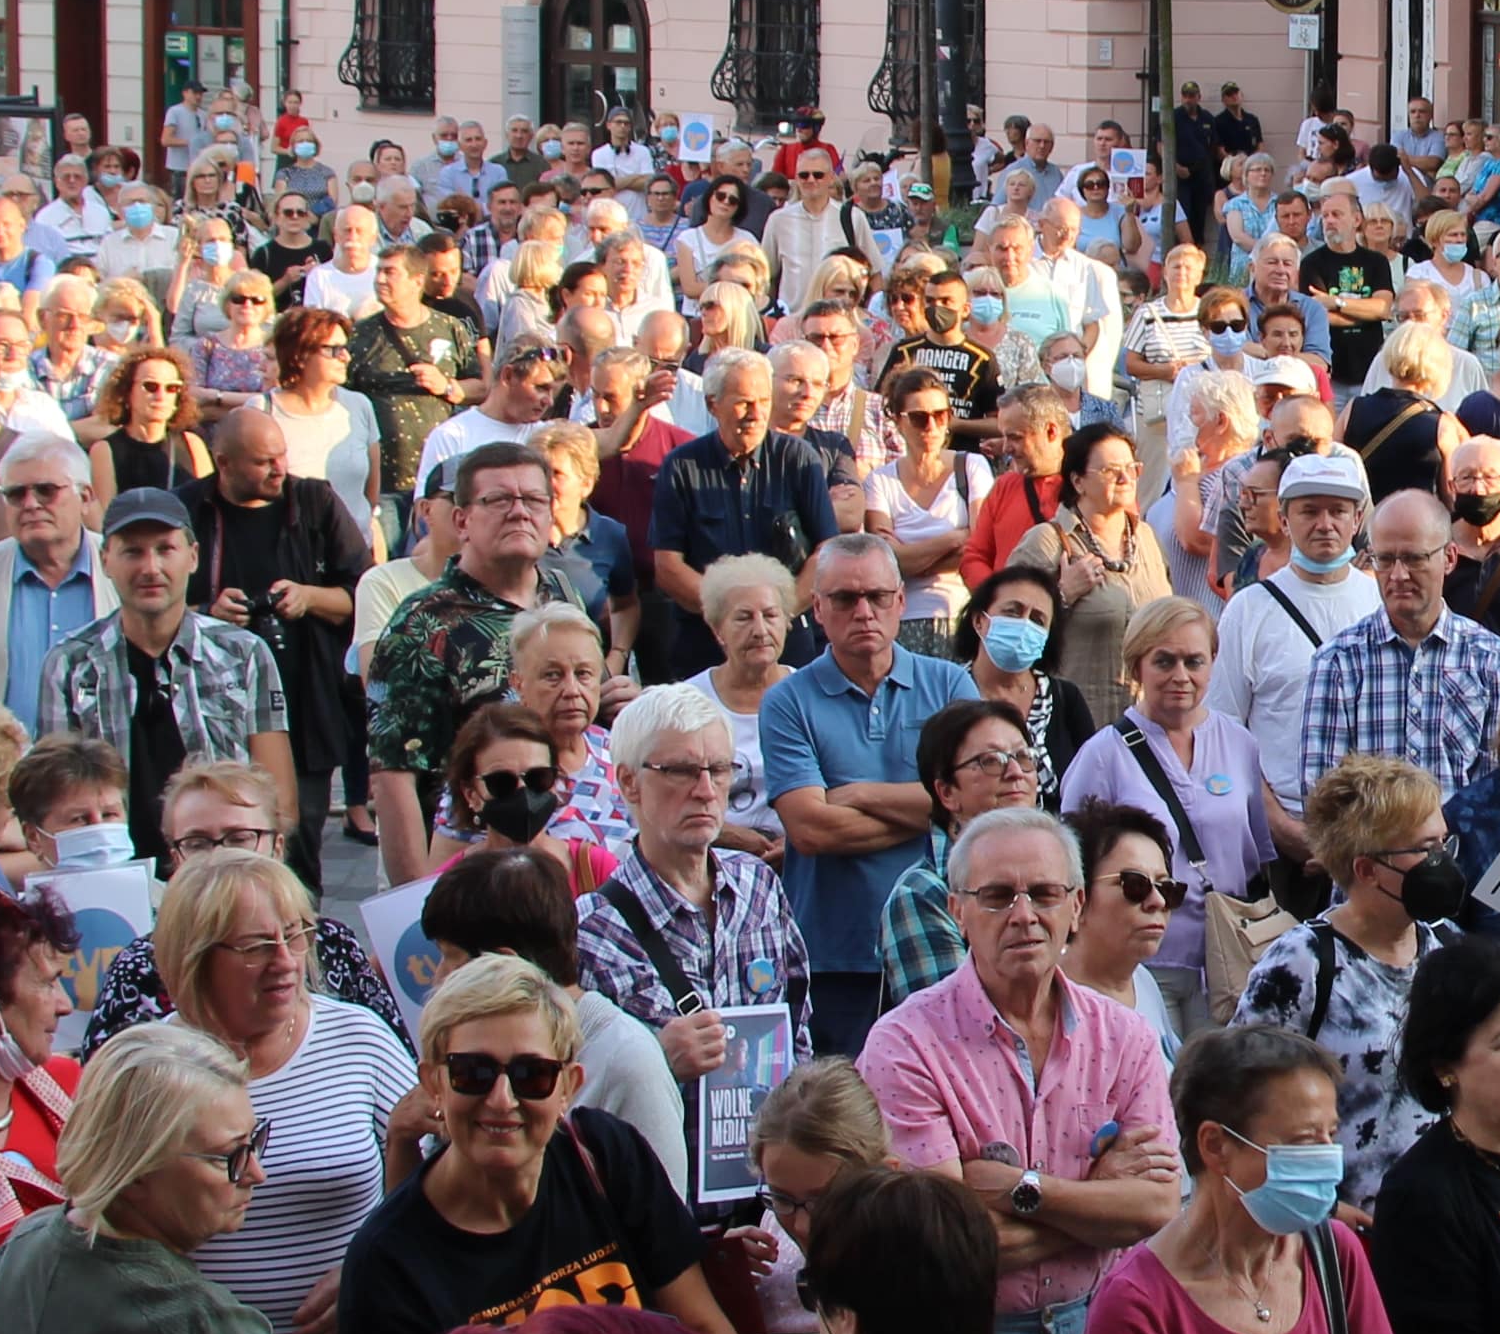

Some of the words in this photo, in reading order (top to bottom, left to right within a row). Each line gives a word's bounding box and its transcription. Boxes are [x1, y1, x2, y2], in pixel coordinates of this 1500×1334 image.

[915, 348, 970, 372] DANGER
[710, 1086, 753, 1120] WOLNE
[711, 1117, 747, 1148] MEDIA
